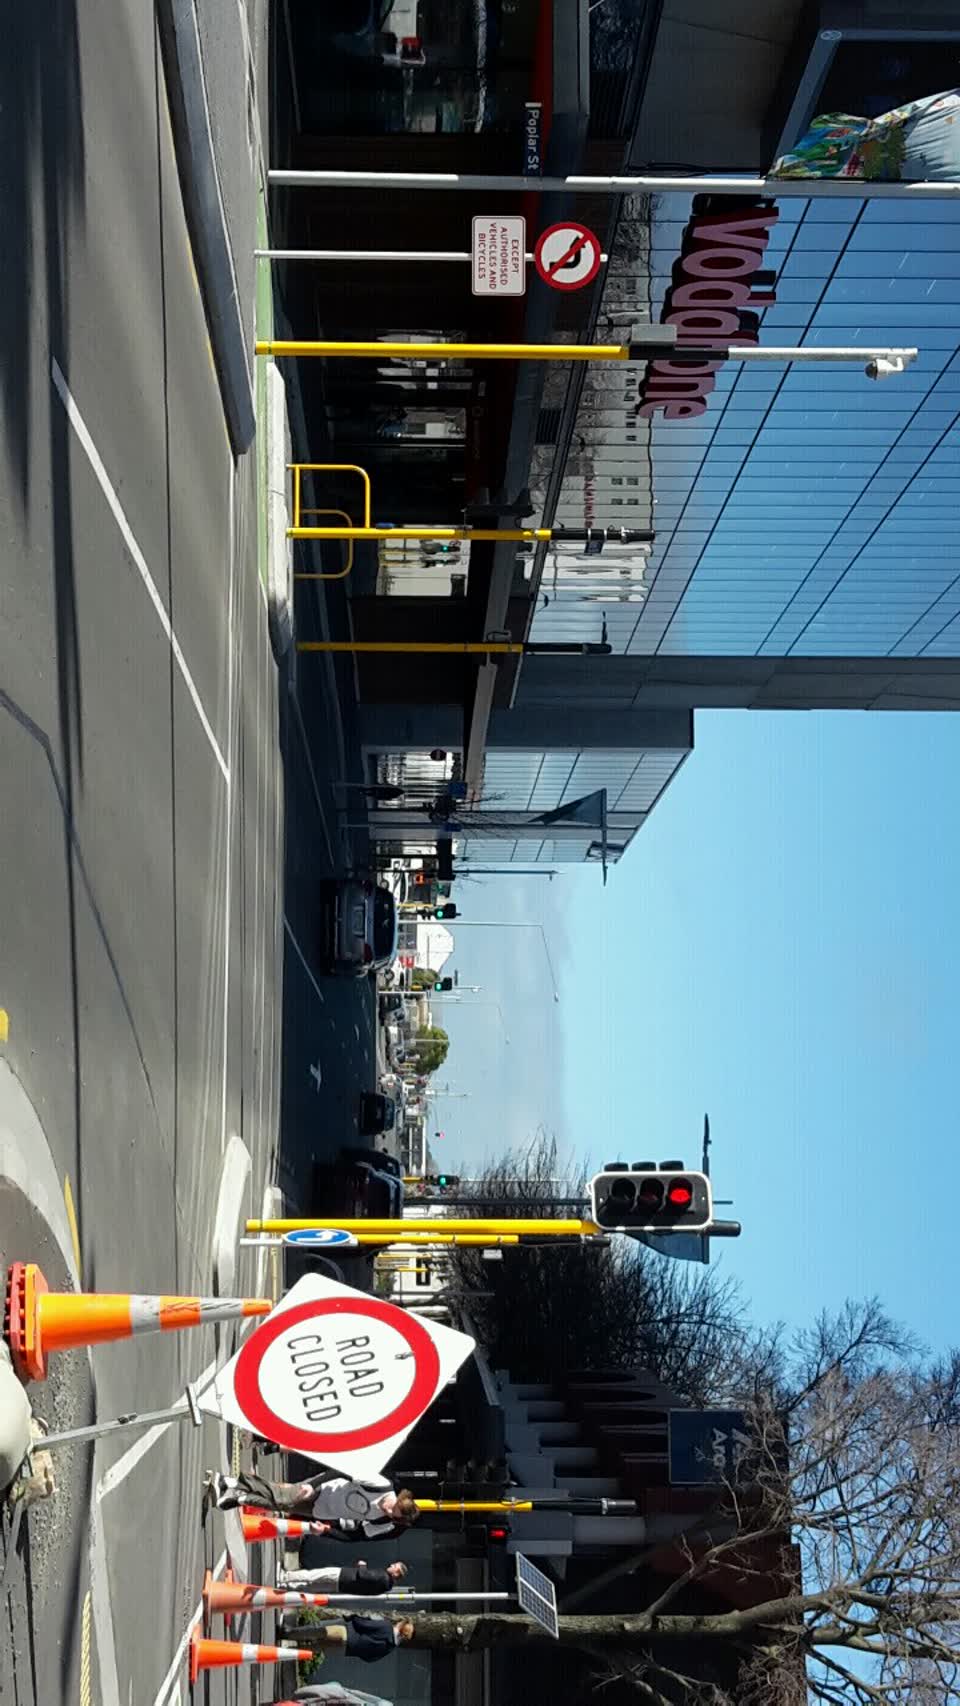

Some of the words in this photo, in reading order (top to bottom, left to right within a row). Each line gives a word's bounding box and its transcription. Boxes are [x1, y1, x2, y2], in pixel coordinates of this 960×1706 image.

[526, 109, 539, 151] Poplar
[528, 155, 539, 170] St
[478, 233, 486, 279] BICYCLES
[489, 222, 497, 267] VEHICLES
[500, 227, 508, 285] AUTHORISED
[511, 240, 519, 274] EXCEPT
[489, 270, 497, 290] AND
[286, 1334, 342, 1422] CLOSED
[335, 1335, 385, 1397] ROAD
